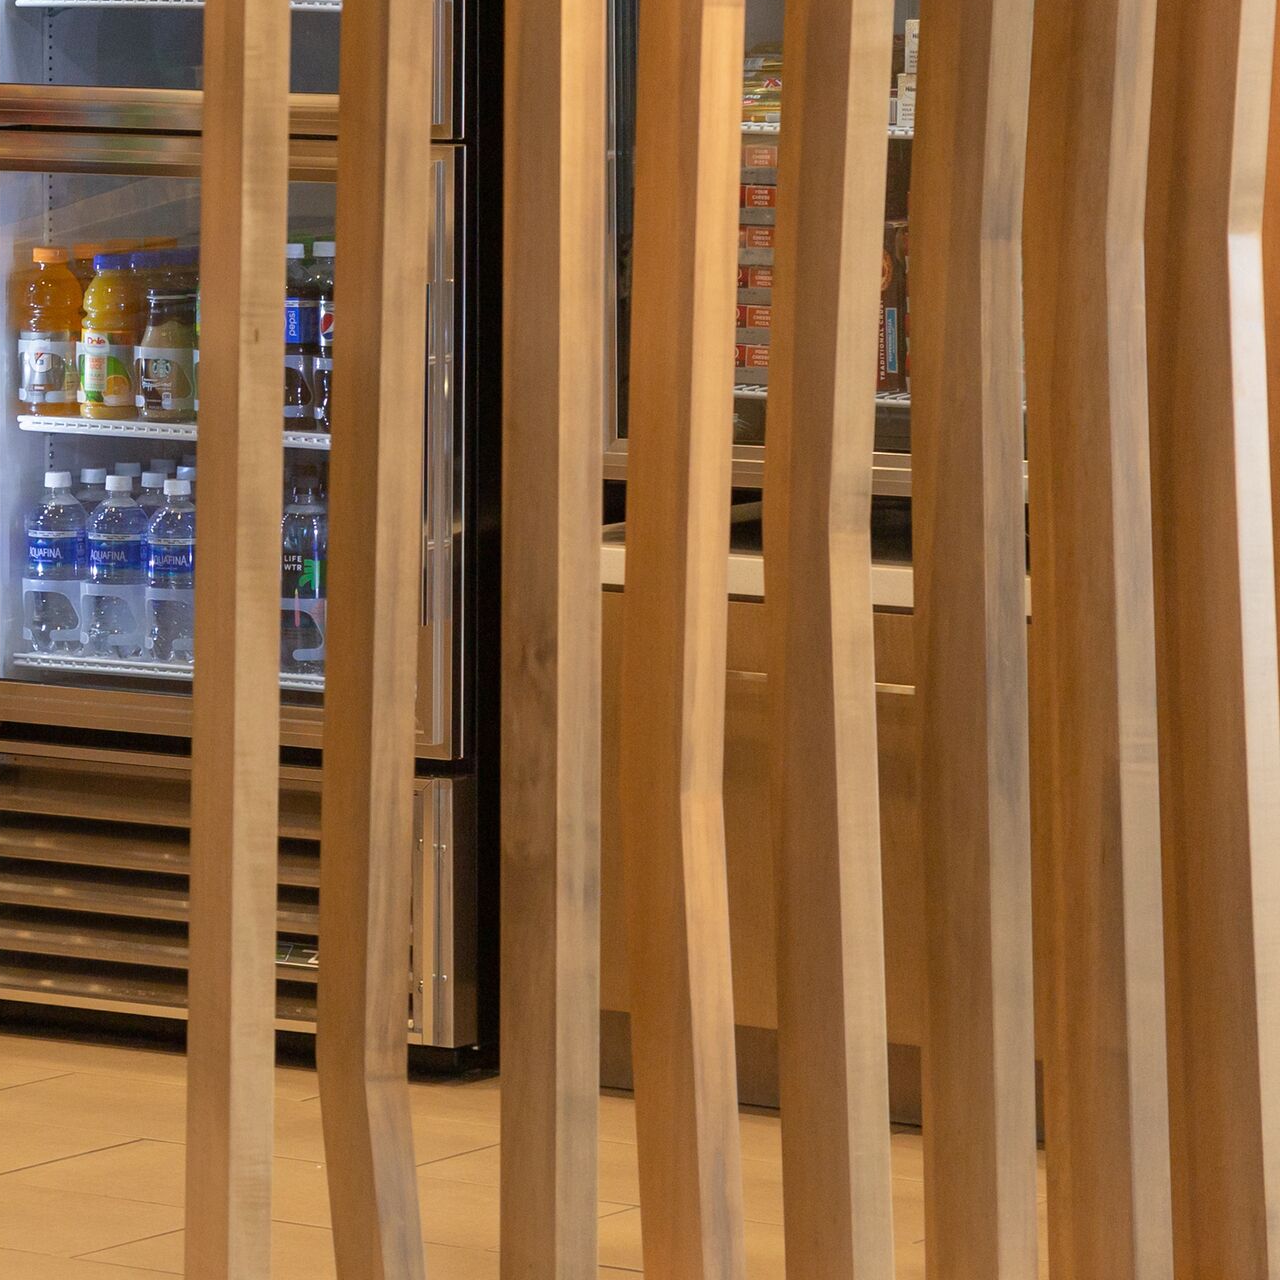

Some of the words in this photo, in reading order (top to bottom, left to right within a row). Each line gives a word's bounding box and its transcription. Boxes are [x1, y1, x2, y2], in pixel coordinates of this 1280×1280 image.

[289, 310, 297, 337] pepsi
[87, 336, 106, 345] Dole
[90, 549, 126, 562] AQUAFINA
[284, 555, 303, 563] LIFE
[284, 563, 303, 571] WTR
